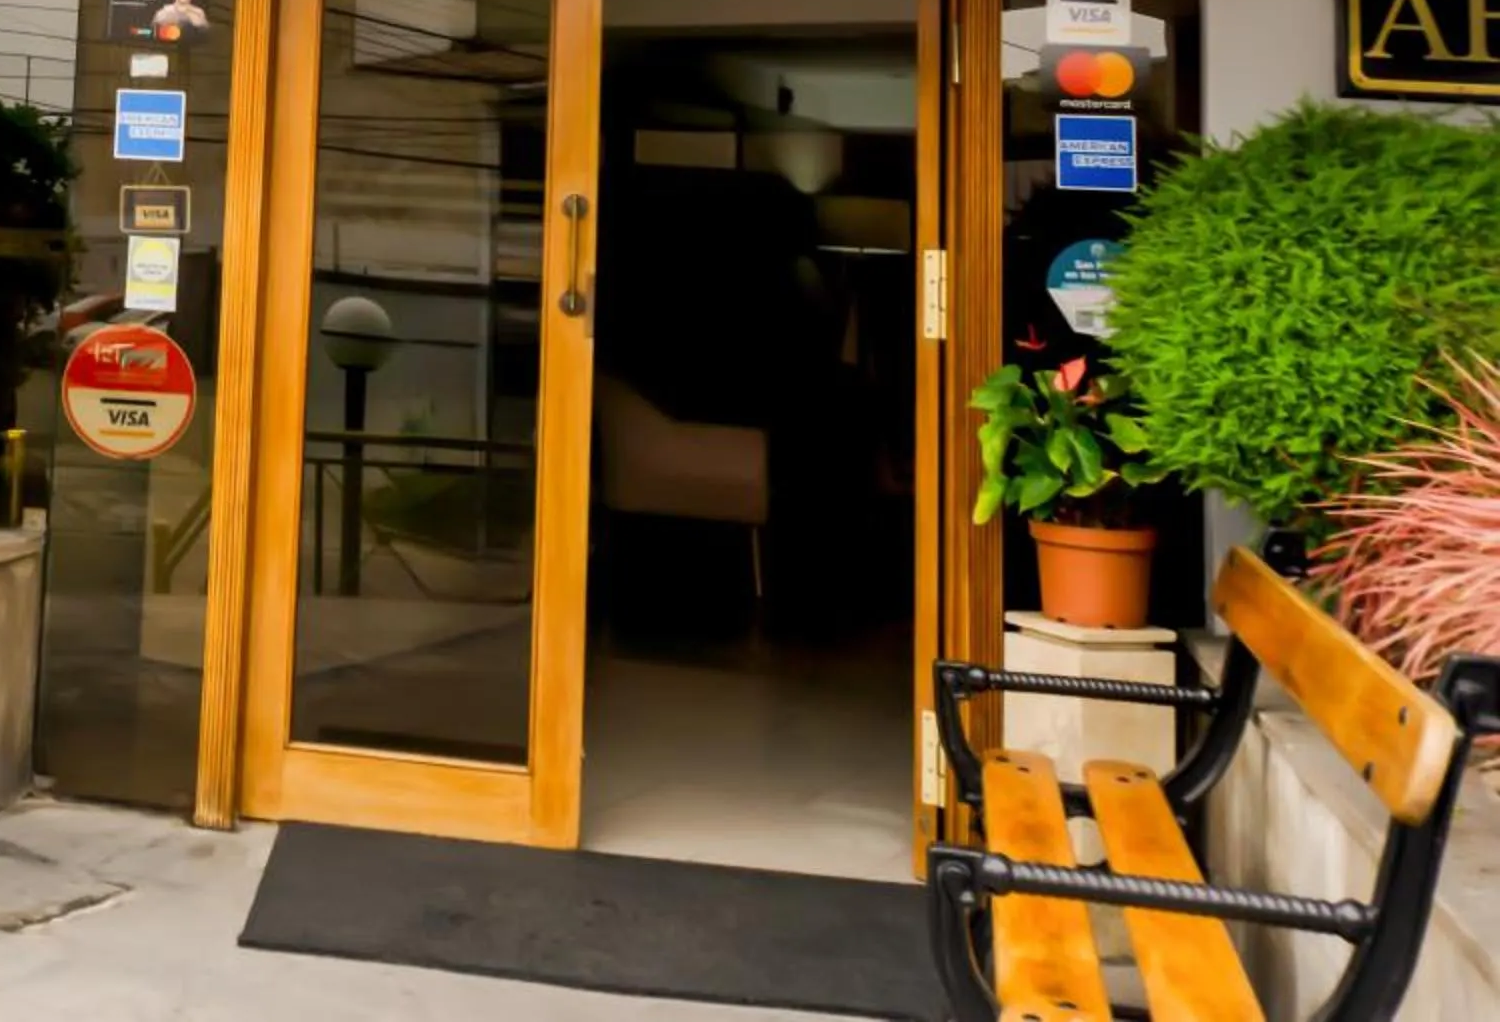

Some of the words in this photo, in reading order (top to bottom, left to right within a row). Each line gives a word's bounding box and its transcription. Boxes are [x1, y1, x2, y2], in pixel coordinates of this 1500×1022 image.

[1068, 6, 1112, 23] VISA
[1060, 142, 1128, 151] AMERICAN
[142, 209, 170, 220] VISA
[108, 409, 150, 427] VISA
